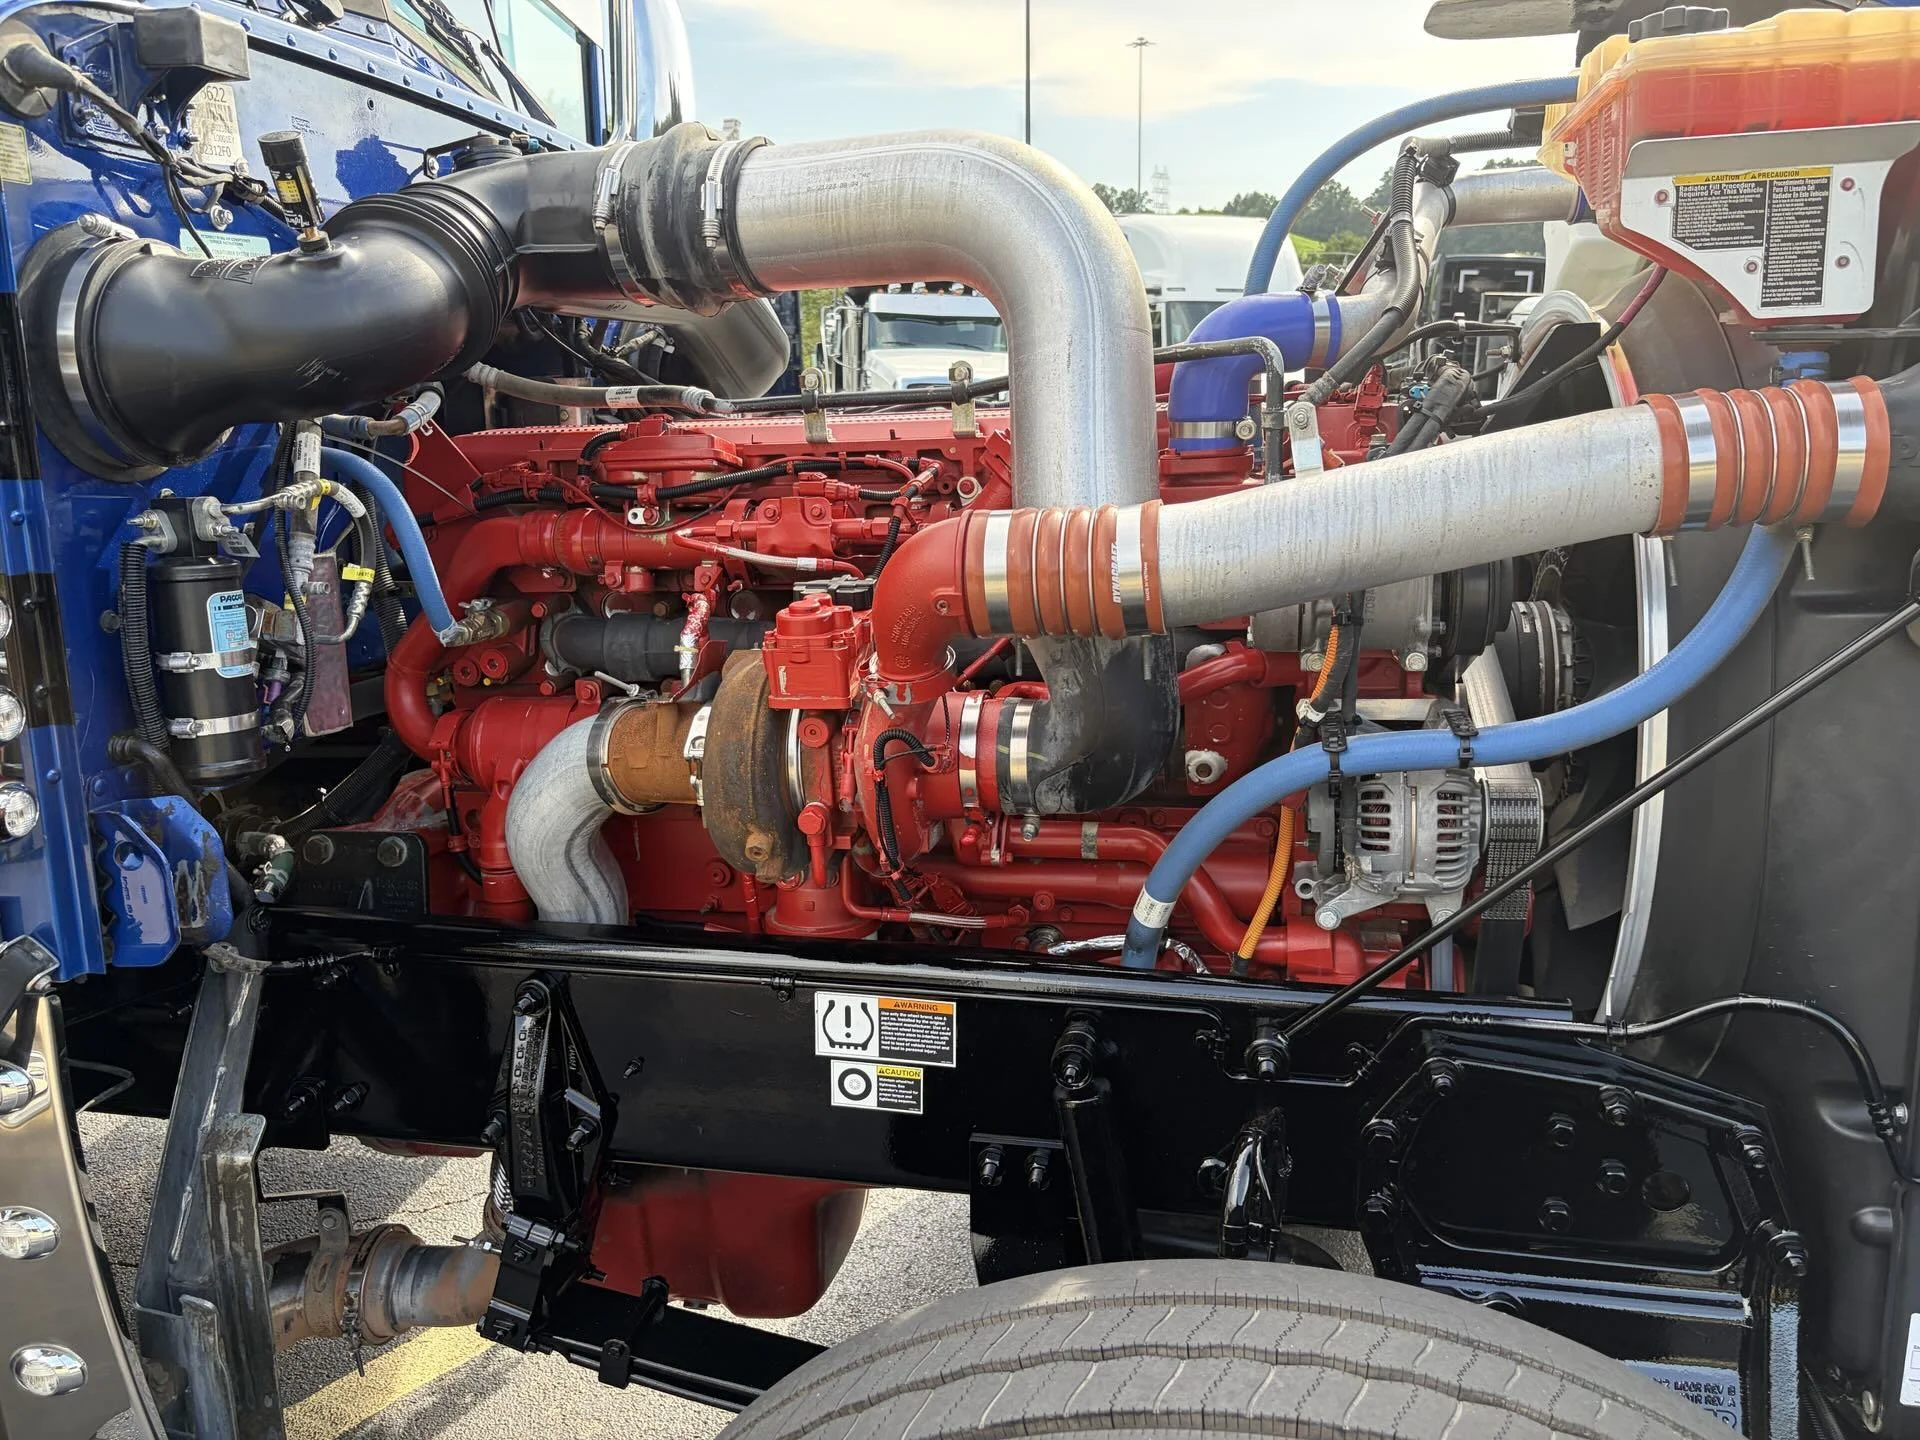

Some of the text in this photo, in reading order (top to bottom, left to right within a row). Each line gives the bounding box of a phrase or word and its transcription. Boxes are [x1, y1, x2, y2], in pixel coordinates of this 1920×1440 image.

[1680, 184, 1707, 192] Radiator
[1679, 190, 1708, 198] Required
[900, 1002, 938, 1011] WARNING
[885, 1069, 920, 1077] CAUTION
